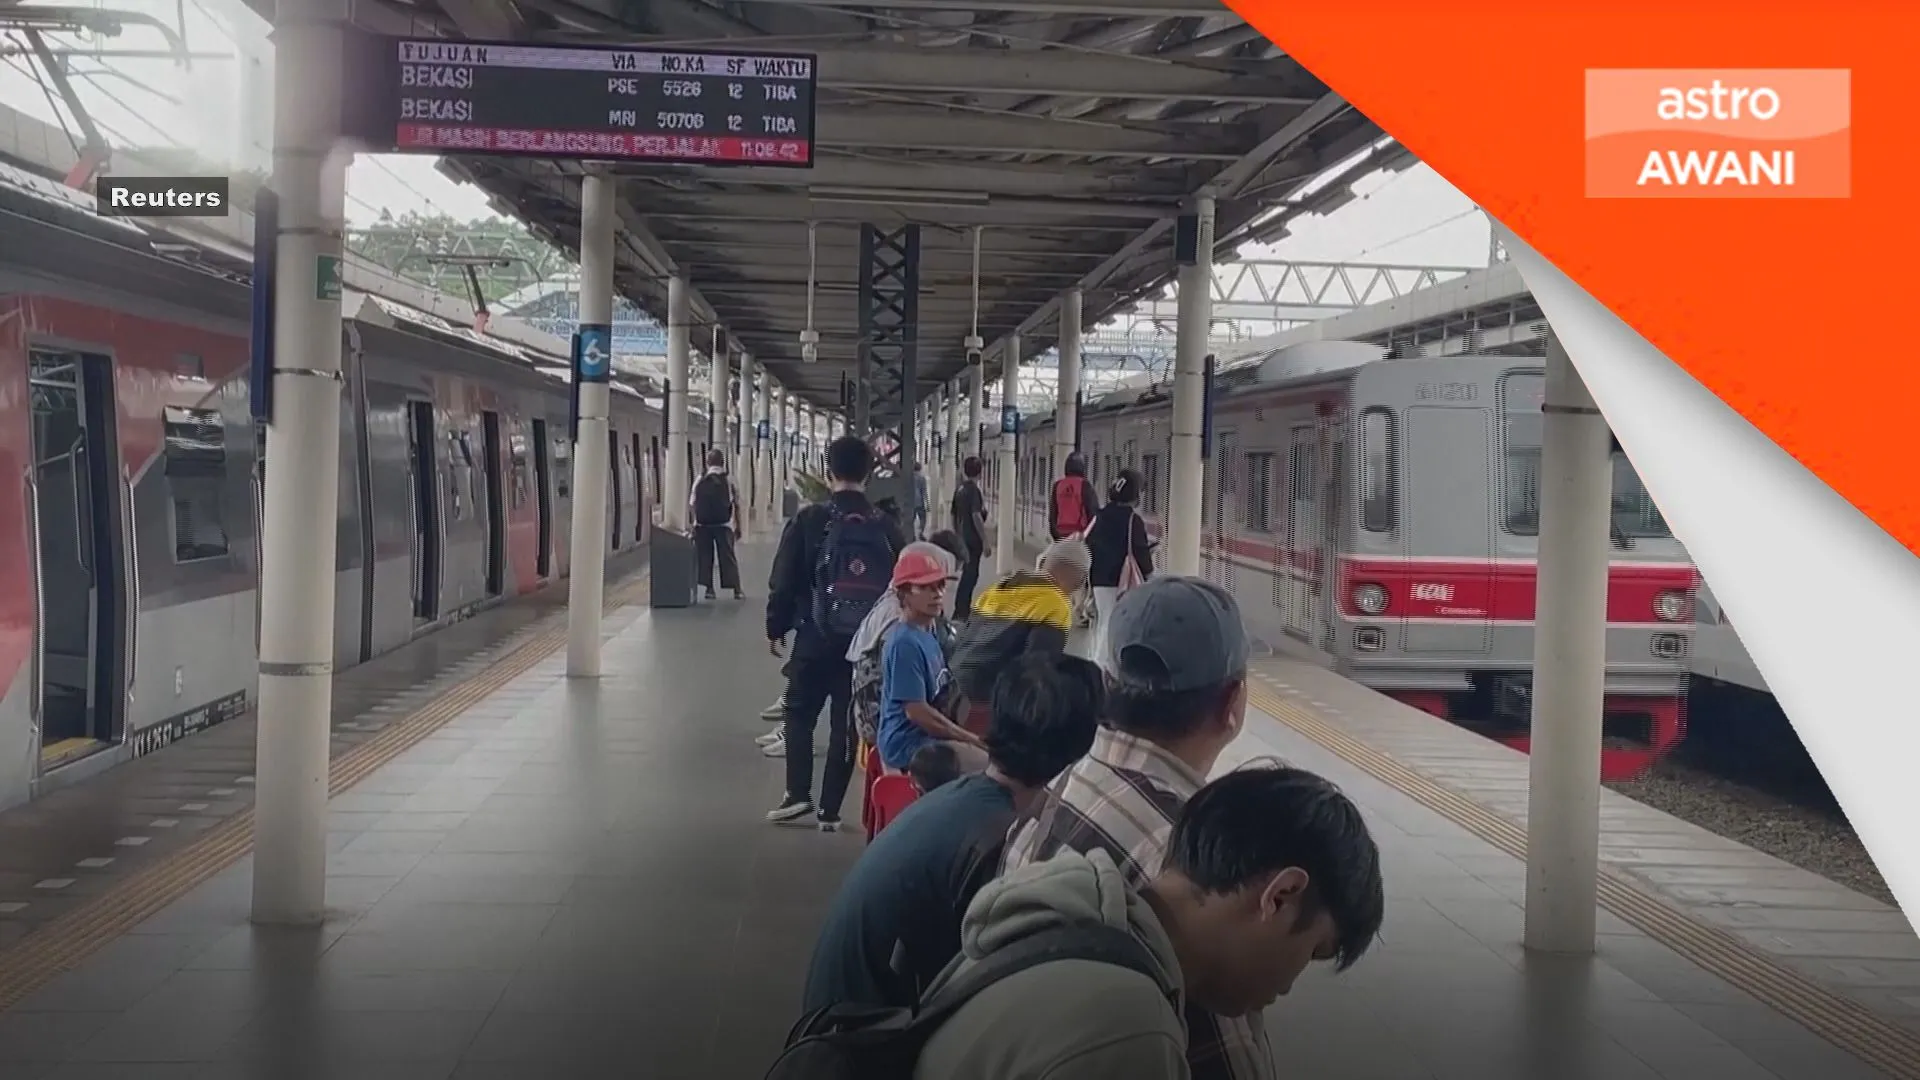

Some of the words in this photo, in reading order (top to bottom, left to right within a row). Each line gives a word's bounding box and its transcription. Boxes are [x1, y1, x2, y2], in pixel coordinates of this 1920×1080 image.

[403, 43, 489, 64] TUJUAN
[611, 53, 637, 70] VIA
[661, 55, 705, 73] NO.KA
[726, 58, 746, 75] SF
[754, 59, 806, 76] WAKTU
[401, 64, 474, 89] BEKASI
[607, 78, 639, 95] PSE
[727, 82, 744, 100] 12
[762, 84, 797, 101] TIBA
[400, 97, 473, 121] BEKASI
[608, 109, 637, 127] MRI
[727, 114, 743, 131] 12
[761, 115, 796, 133] TIBA
[435, 127, 492, 148] MASIH
[583, 338, 602, 367] 6
